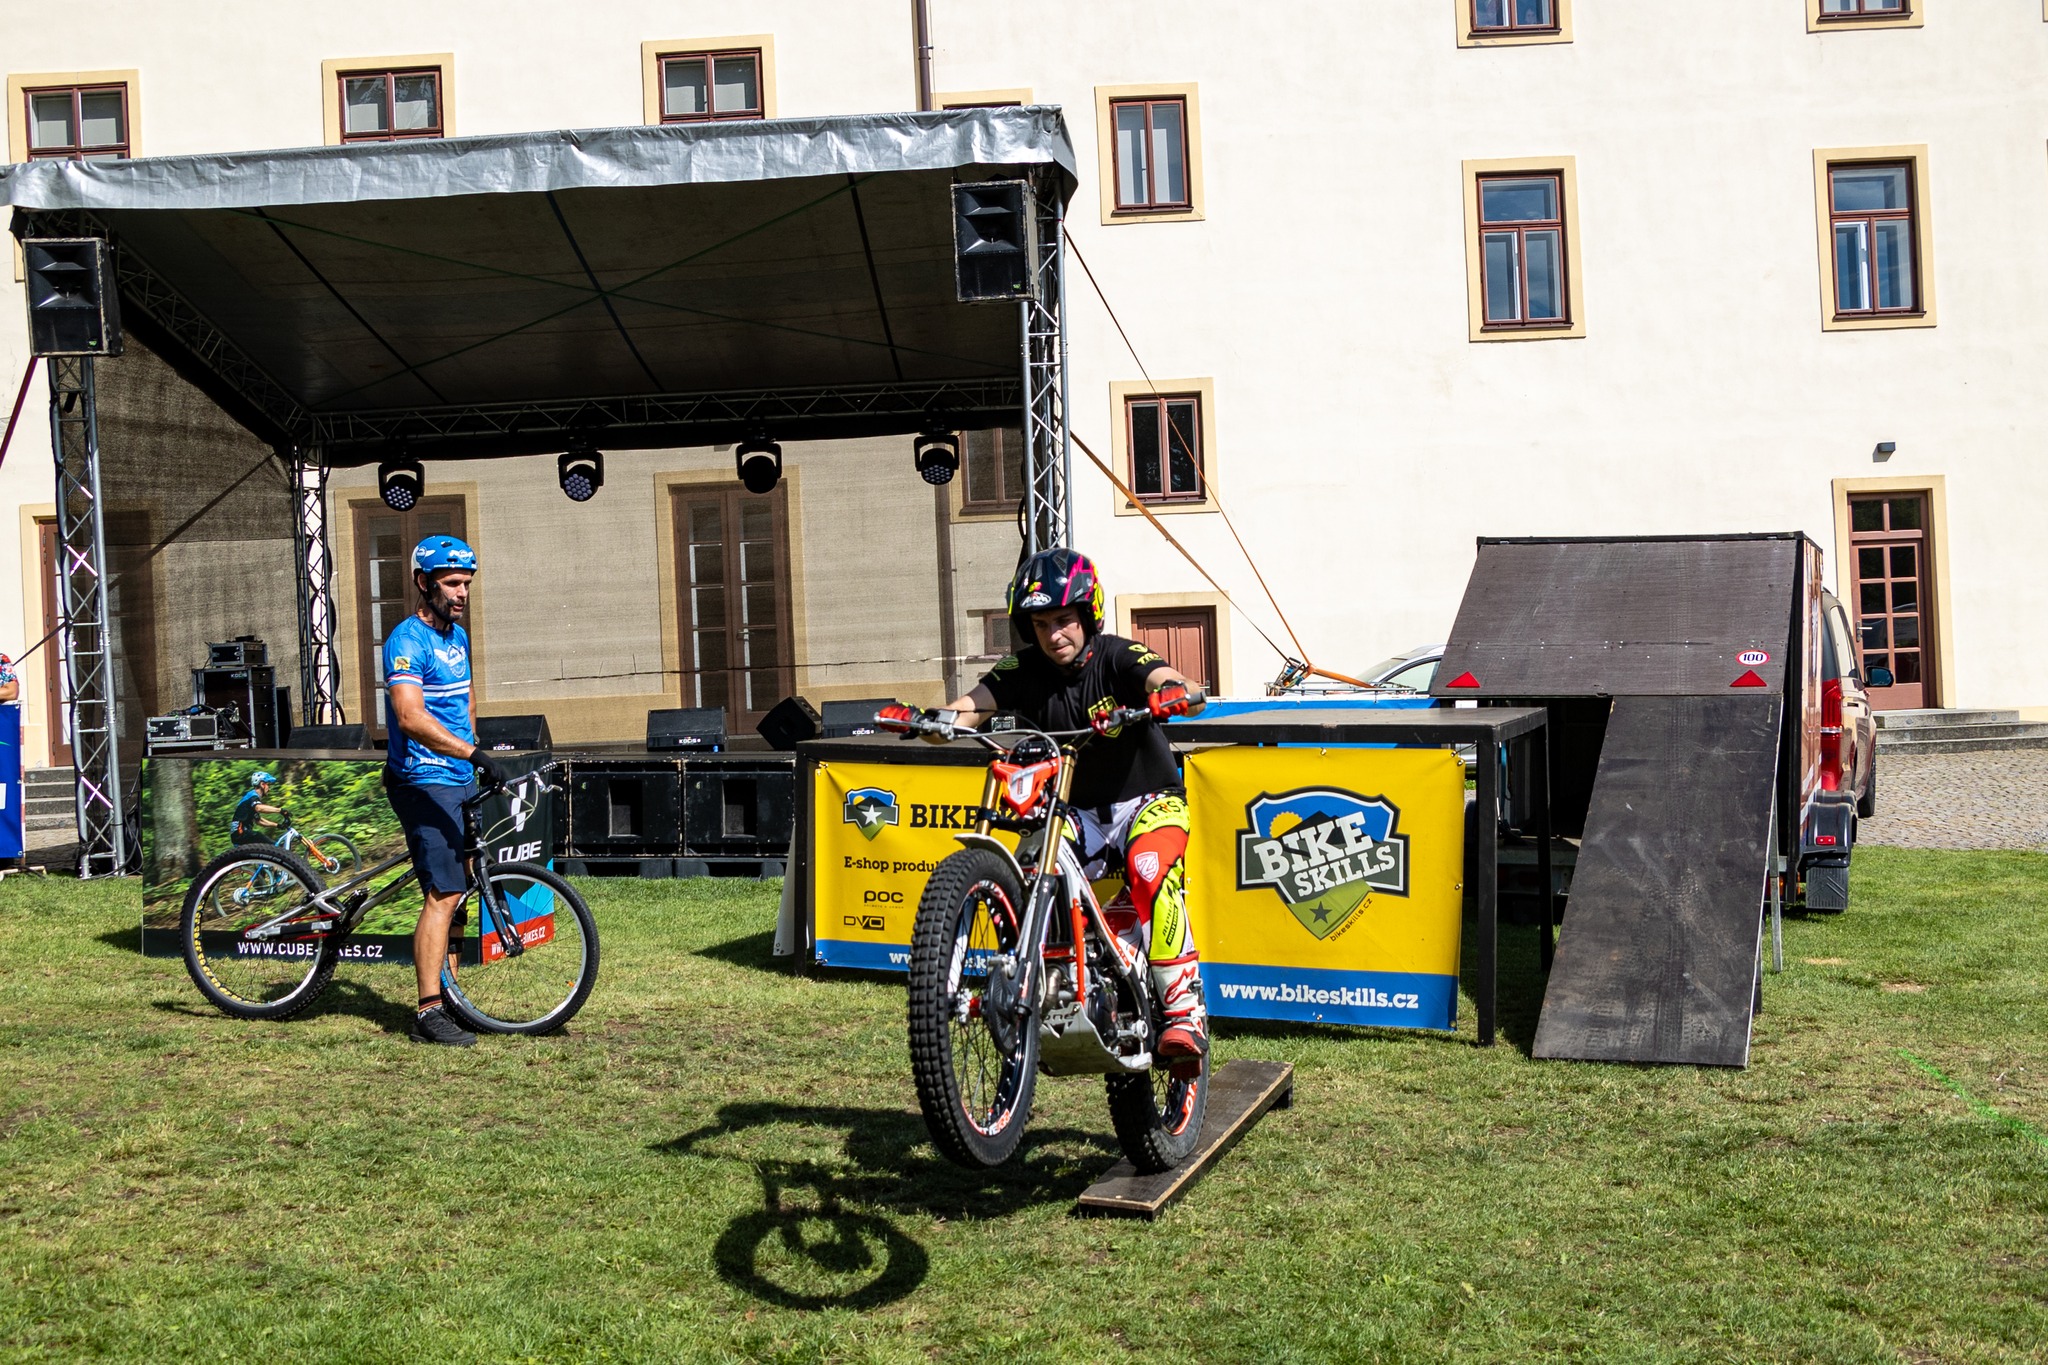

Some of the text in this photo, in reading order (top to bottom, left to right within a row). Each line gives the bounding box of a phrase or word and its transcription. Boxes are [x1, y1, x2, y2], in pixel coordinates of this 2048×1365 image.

[1743, 653, 1764, 662] 100
[498, 840, 542, 863] CUBE
[1253, 811, 1374, 881] BIKE
[844, 856, 889, 873] E-shop
[1294, 845, 1396, 897] SKILLS
[844, 915, 884, 930] DVO
[1330, 898, 1373, 942] bikeskills.cz
[1219, 983, 1419, 1009] www.bikeskills.cz
